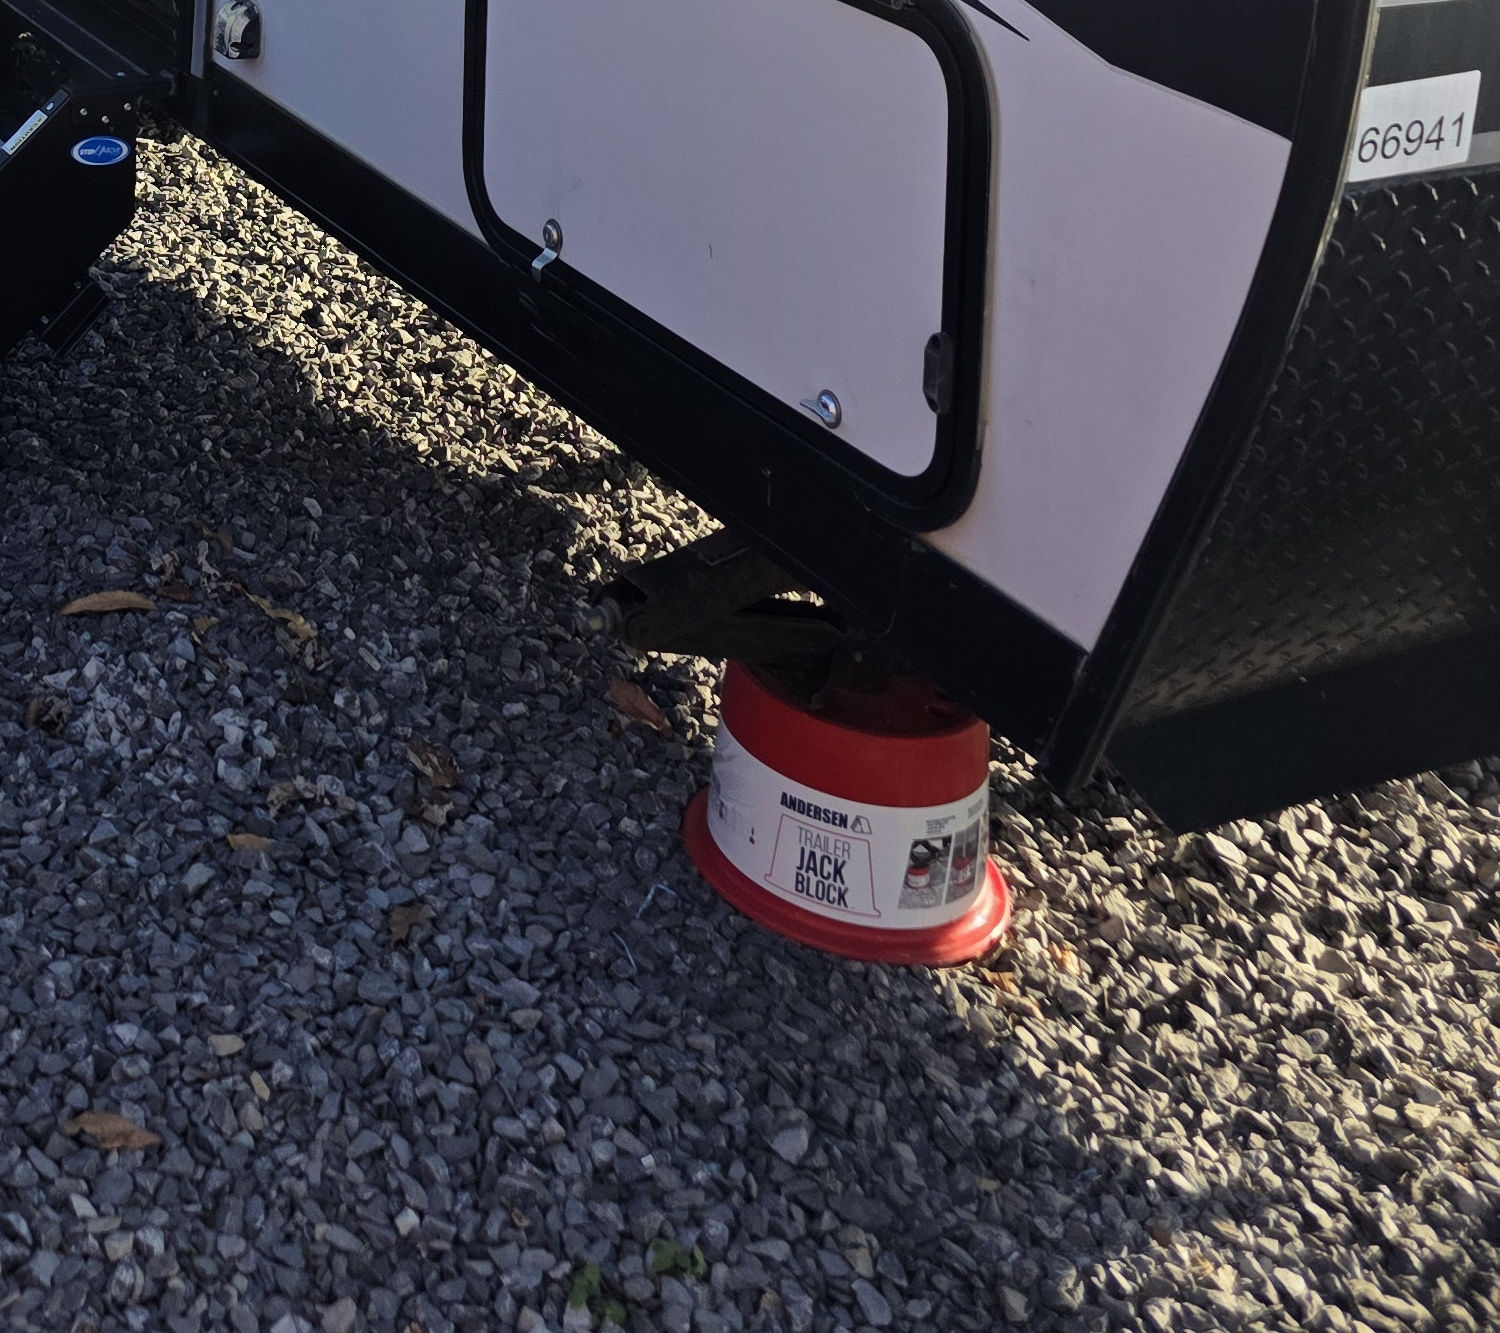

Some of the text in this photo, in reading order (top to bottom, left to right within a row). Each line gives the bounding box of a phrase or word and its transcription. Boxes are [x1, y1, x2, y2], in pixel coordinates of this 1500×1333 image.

[1357, 111, 1466, 163] 66941
[779, 791, 849, 830] ANDERSEN
[797, 825, 851, 860] TRAILER
[795, 846, 847, 886] JACK
[794, 870, 849, 909] BLOCK
